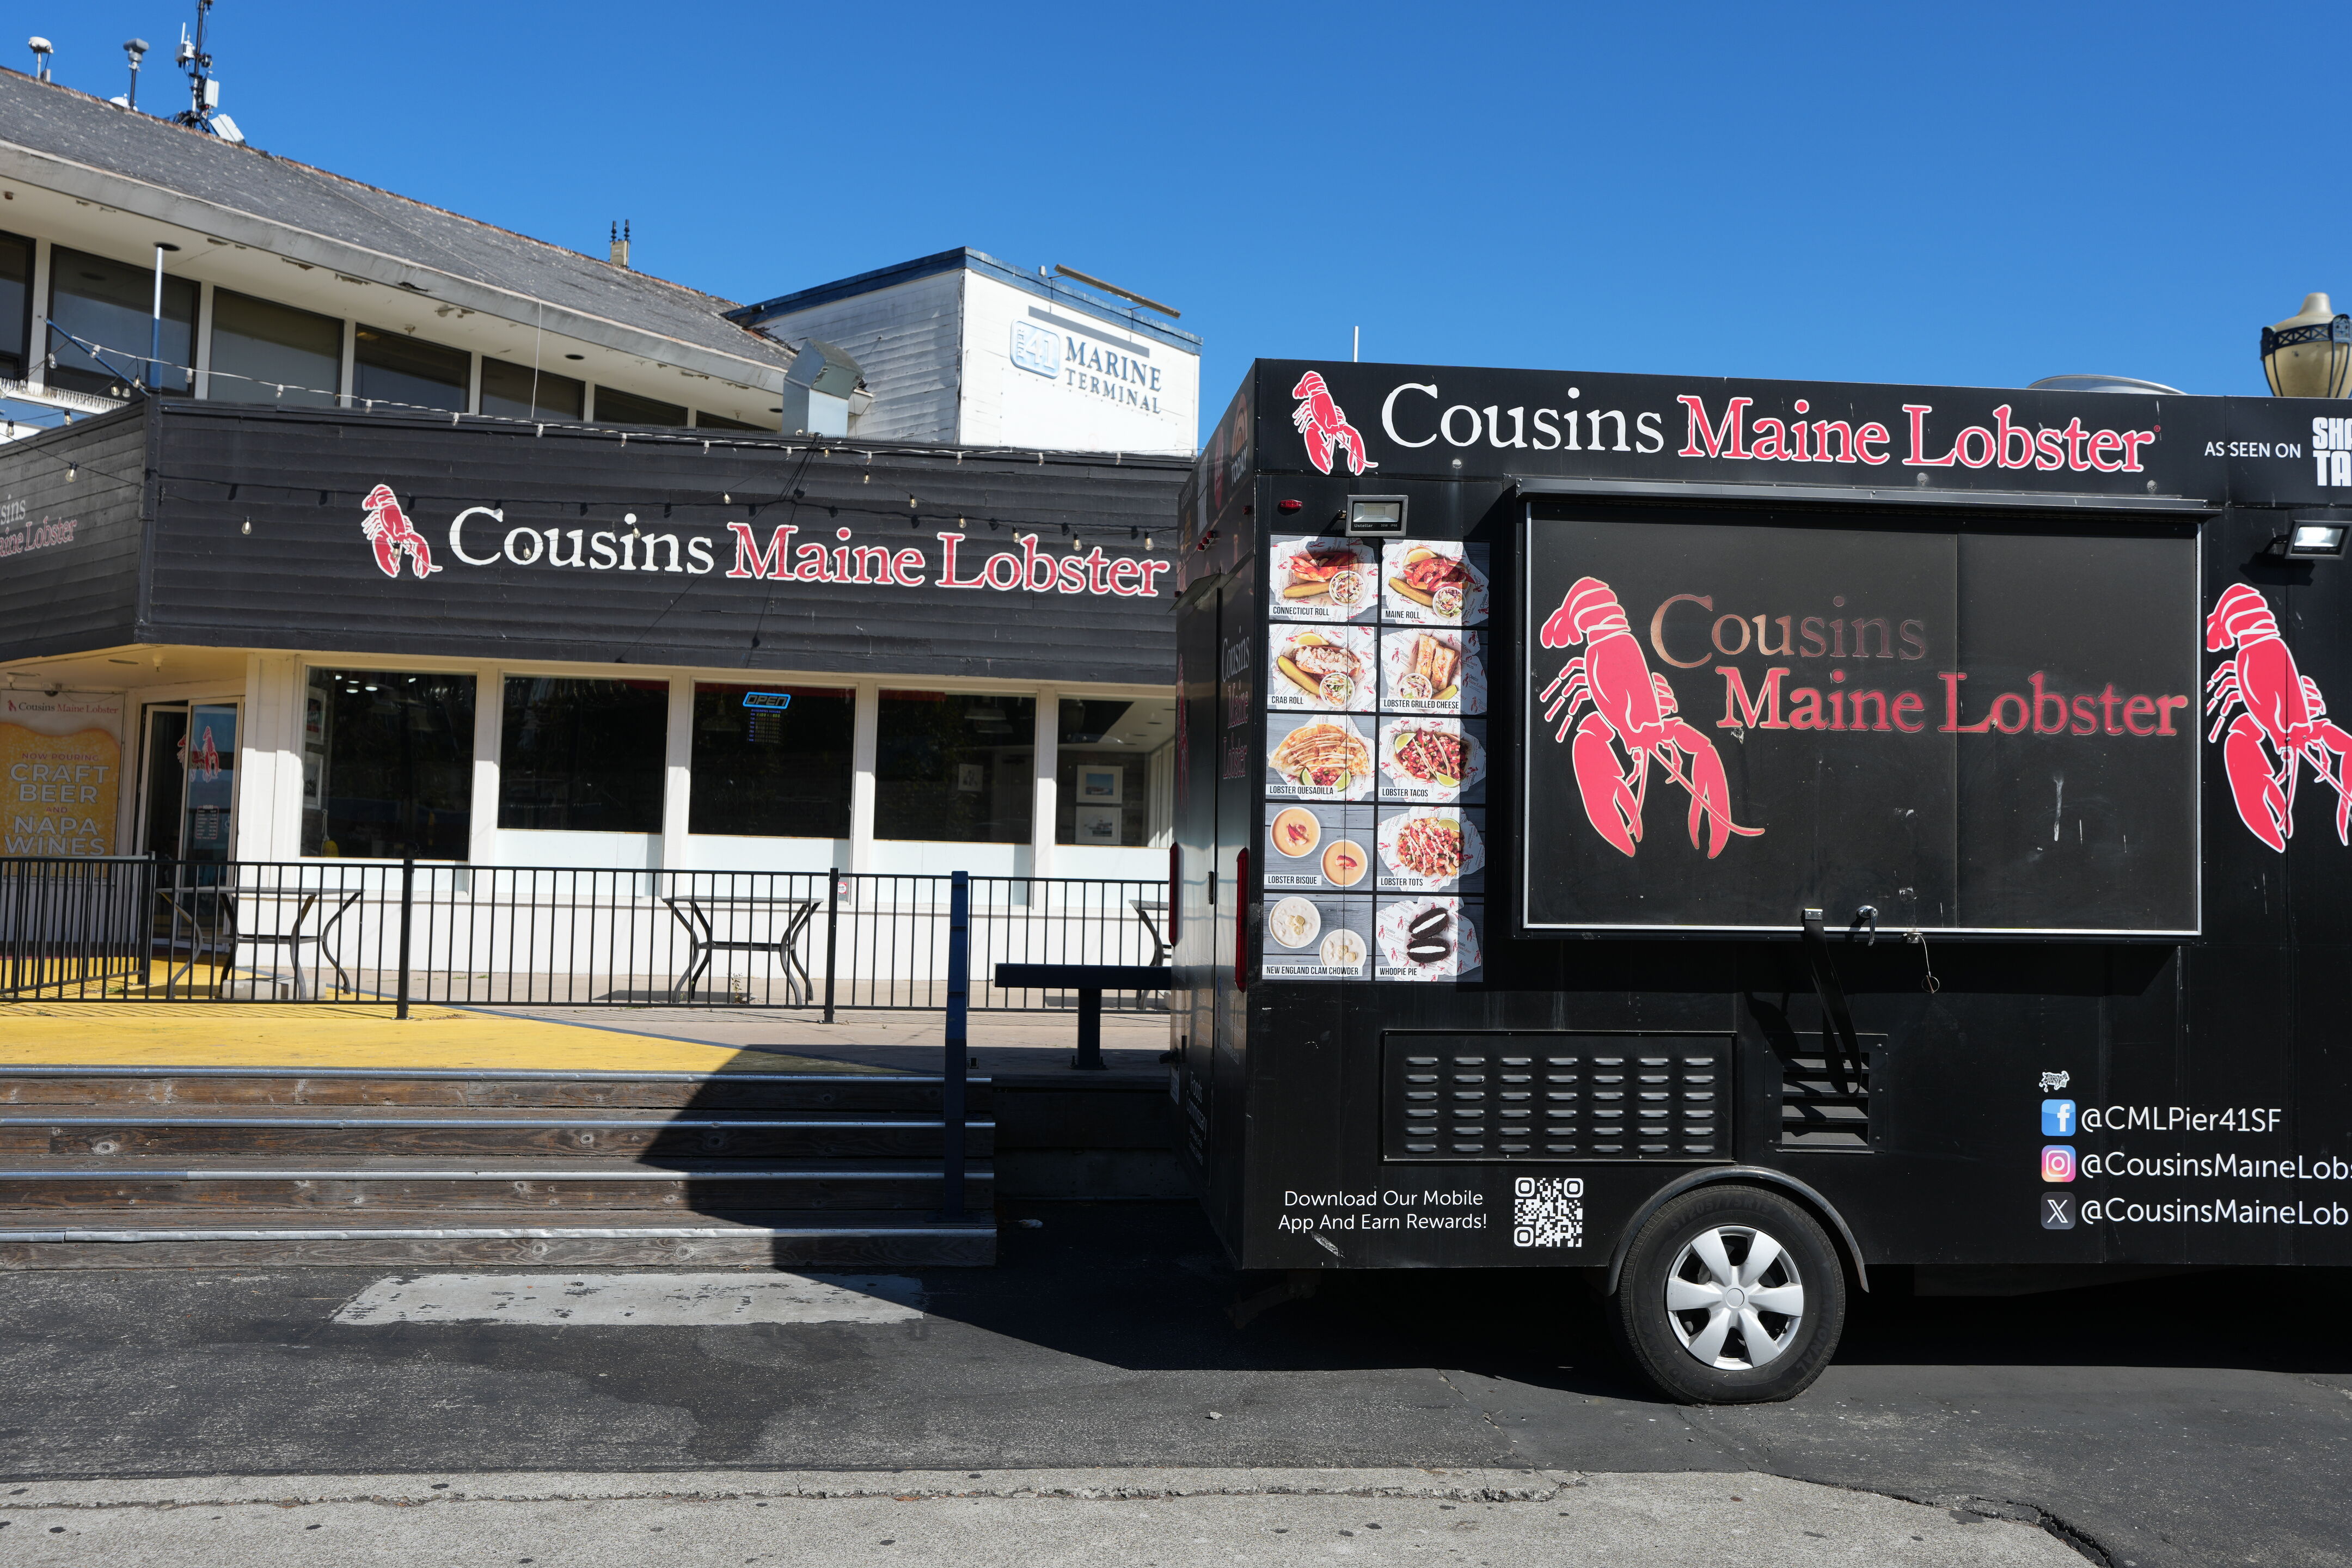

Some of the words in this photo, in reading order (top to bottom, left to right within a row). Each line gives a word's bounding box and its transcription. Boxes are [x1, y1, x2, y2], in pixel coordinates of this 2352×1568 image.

[1025, 330, 1055, 371] 41
[1065, 336, 1162, 392] MARINE
[1065, 367, 1161, 414] TERMINAL
[1382, 383, 1664, 454] Cousins
[1677, 394, 1890, 465] Maine
[1902, 404, 2155, 473] Lobster
[2204, 442, 2225, 457] AS
[2230, 442, 2270, 457] SEEN
[2275, 443, 2301, 458] ON
[1231, 446, 1248, 486] TODAY
[24, 516, 77, 551] Lobster
[449, 506, 715, 574] Cousins
[726, 522, 926, 587] Maine
[935, 531, 1171, 597] Lobster
[1273, 606, 1314, 615] CONNECTICUT
[1315, 608, 1330, 616] ROLL
[1385, 610, 1405, 618] MAINE
[1406, 611, 1420, 619] ROLL
[1650, 593, 1926, 668] Cousins
[1221, 625, 1250, 683] Cousins
[19, 702, 55, 712] Cousins
[57, 703, 84, 713] Maine
[86, 705, 119, 714] Lobster
[746, 695, 787, 706] OPEN
[1227, 679, 1249, 729] Maine
[1271, 696, 1288, 704] CRAB
[1289, 696, 1303, 705] ROLL
[1384, 699, 1410, 707] LOBSTER
[1411, 700, 1435, 708] GRILLED
[1436, 701, 1459, 709] CHEESE
[1715, 666, 1925, 732] Maine
[1937, 670, 2189, 736] Lobster
[1223, 732, 1248, 779] Lobster
[10, 763, 109, 784] CRAFT
[19, 783, 98, 804] BEER
[1270, 786, 1296, 794] LOBSTER
[1297, 786, 1333, 795] QUESADILLA
[1382, 788, 1408, 797] LOBSTER
[1409, 789, 1428, 797] TACOS
[14, 816, 99, 836] NAPA
[4, 835, 105, 856] WINES
[1268, 875, 1295, 884] LOBSTER
[1296, 876, 1317, 885] BISQUE
[1381, 878, 1407, 886] LOBSTER
[1408, 878, 1423, 886] TOTS
[1266, 966, 1280, 974] NEW
[1282, 966, 1309, 975] ENGLAND
[1311, 966, 1328, 975] CLAM
[1329, 966, 1358, 975] CHOWDER
[2081, 1106, 2282, 1132] @CMLPier41SF
[2081, 1151, 2352, 1179] @CousinsMaineLob
[1284, 1190, 1377, 1206] Download
[1383, 1190, 1418, 1206] Our
[1424, 1190, 1483, 1205] Mobile
[2081, 1197, 2349, 1224] @CousinsMaineLob
[1278, 1215, 1314, 1233] App
[1319, 1214, 1355, 1229] And
[1361, 1214, 1400, 1229] Earn
[1407, 1213, 1487, 1229] Rewards!
